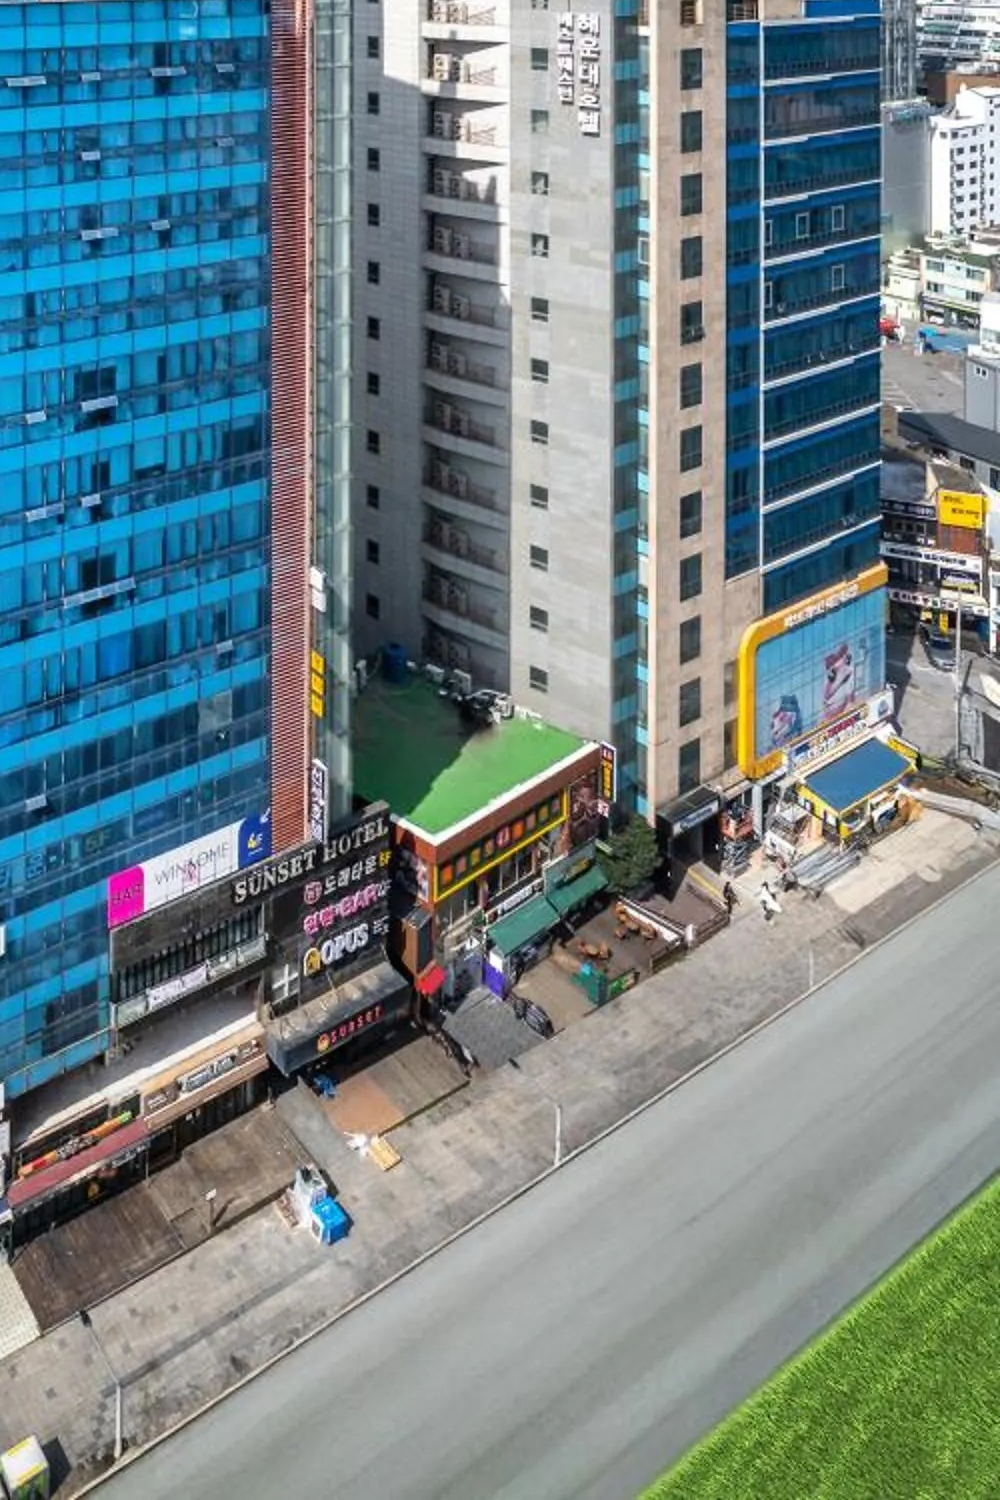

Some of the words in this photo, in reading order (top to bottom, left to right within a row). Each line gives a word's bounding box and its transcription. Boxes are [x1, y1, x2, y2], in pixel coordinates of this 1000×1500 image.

[578, 12, 600, 135] 해운대호텔
[234, 849, 317, 903] SUNSET
[322, 818, 389, 863] HOTEL
[324, 855, 377, 895] 노래타운
[321, 923, 369, 965] OPUS
